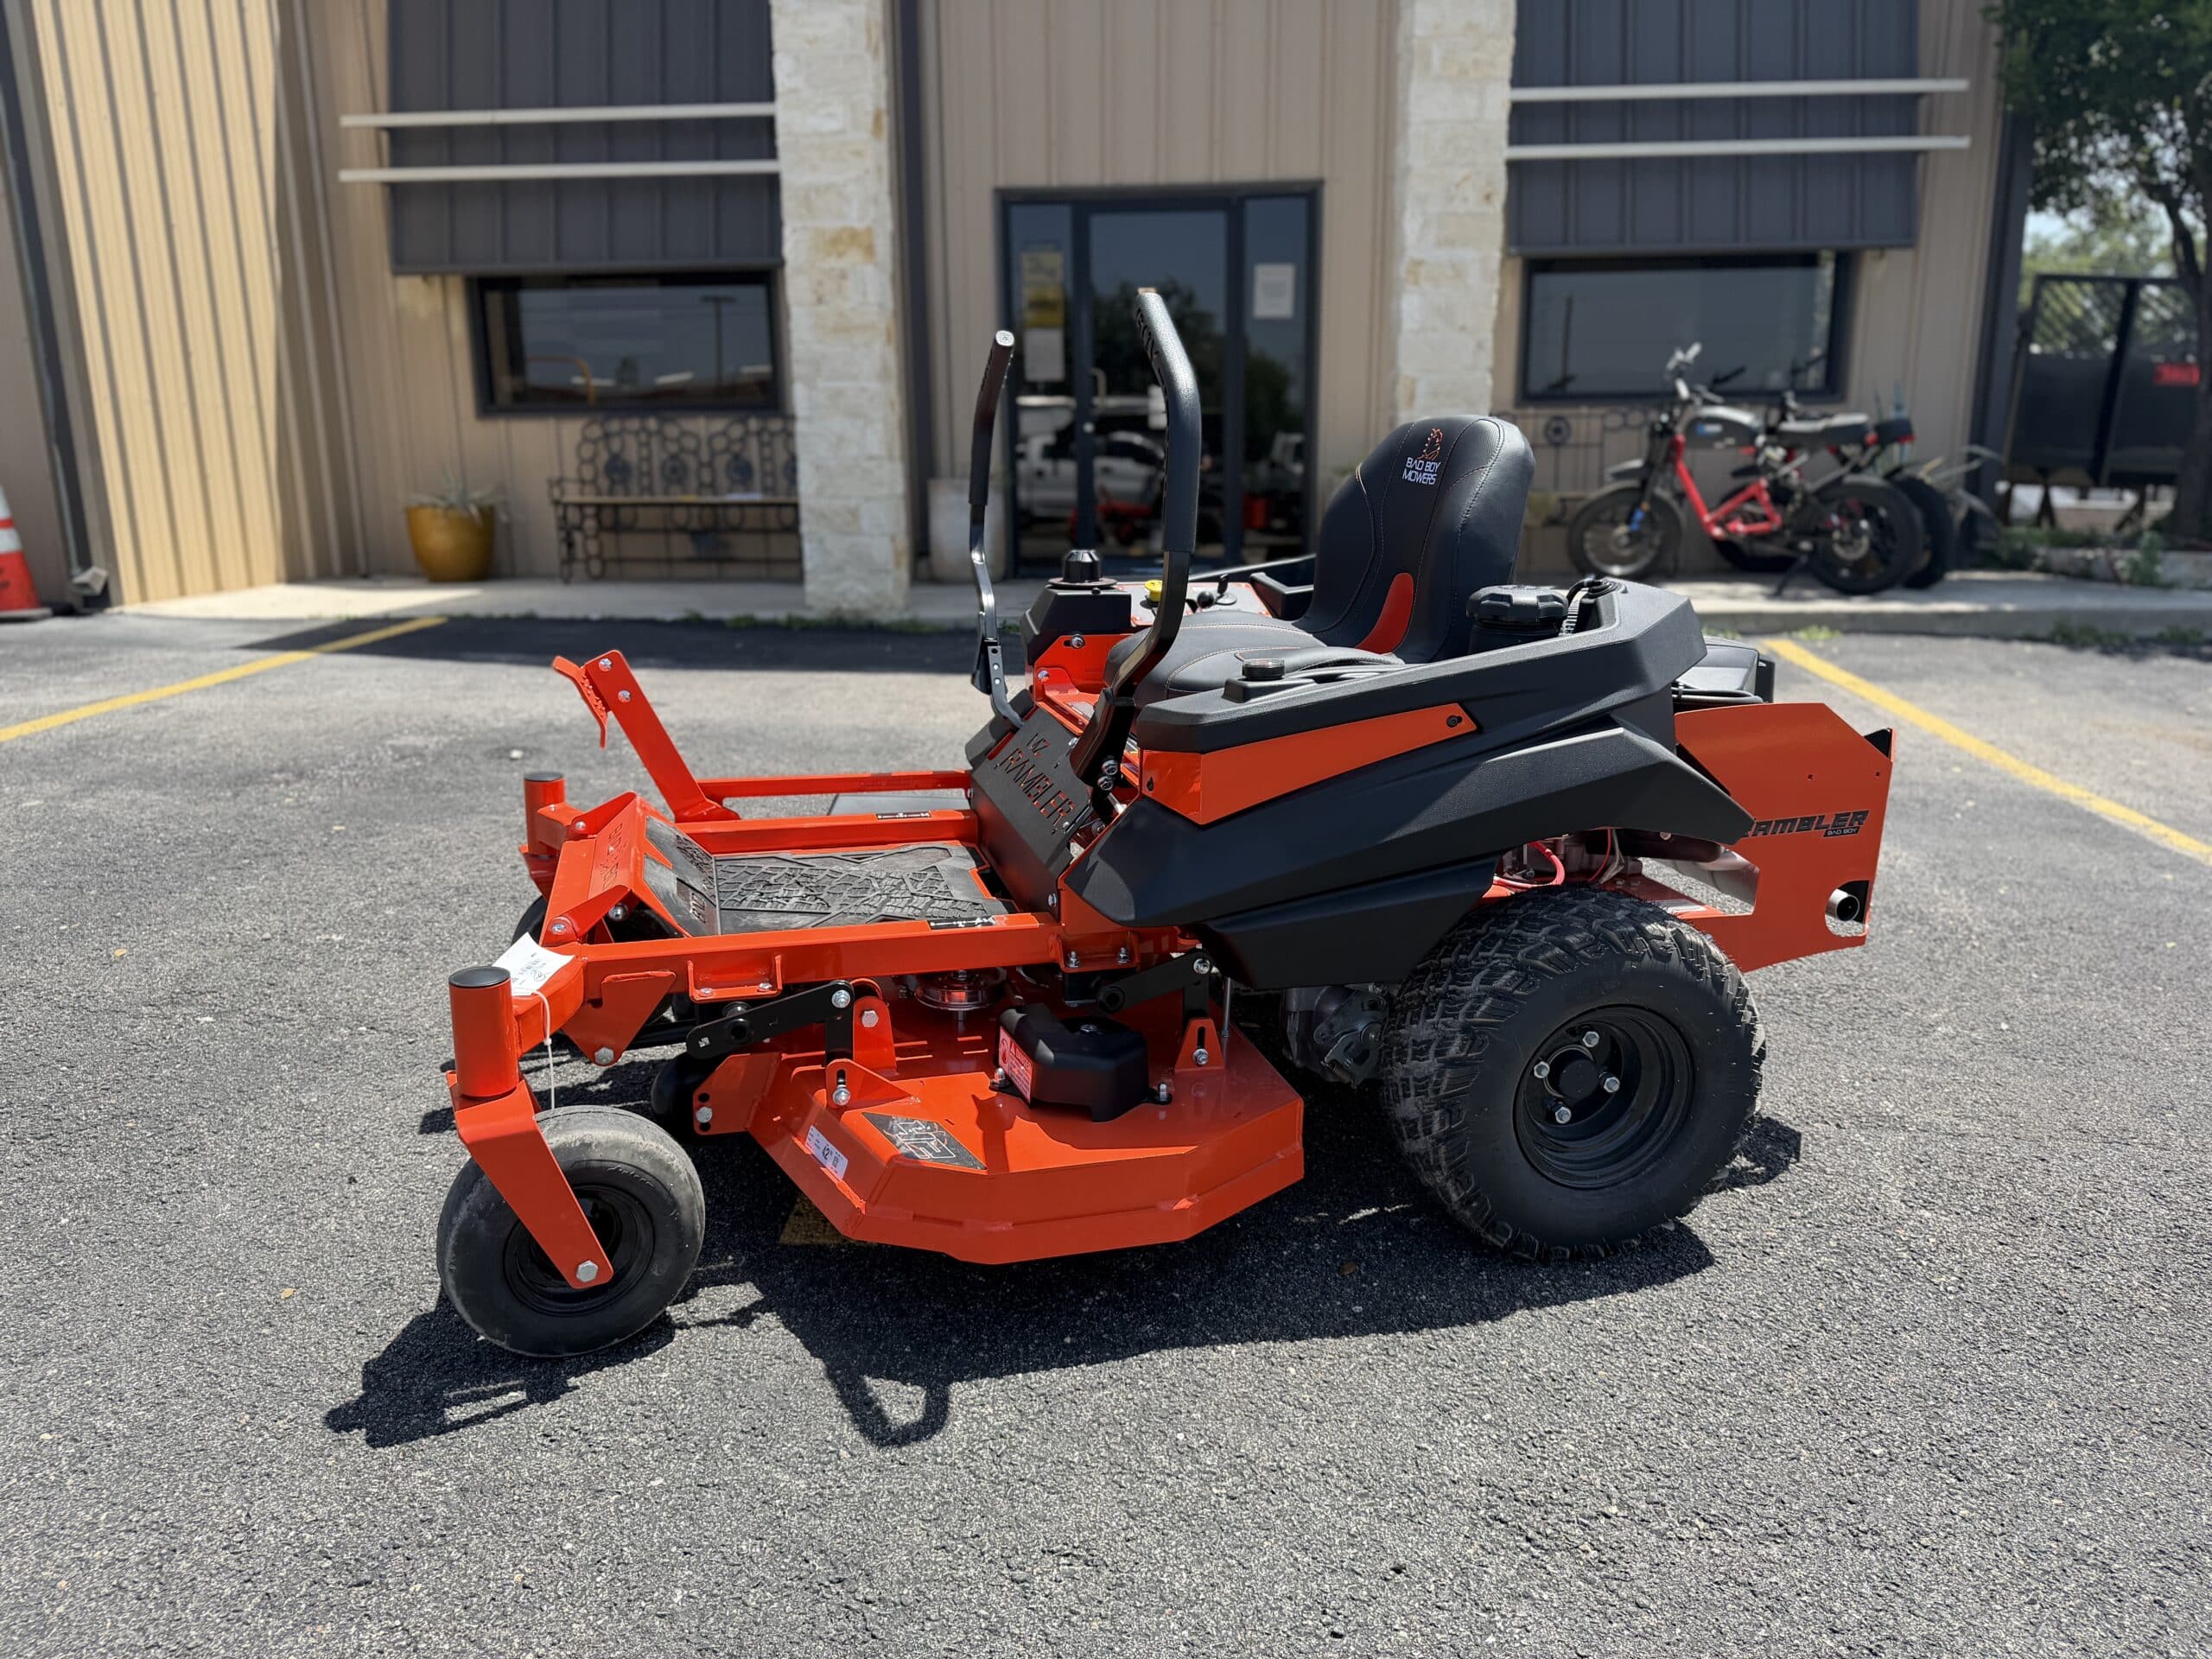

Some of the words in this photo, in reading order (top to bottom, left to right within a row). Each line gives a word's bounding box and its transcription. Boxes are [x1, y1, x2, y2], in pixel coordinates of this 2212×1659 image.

[1406, 457, 1423, 470] BAD
[1425, 461, 1441, 473] BOY
[1402, 468, 1438, 485] MOWERS
[1000, 748, 1076, 827] RAMBLER
[1746, 810, 1869, 837] AMBLER
[822, 1145, 830, 1160] 42
